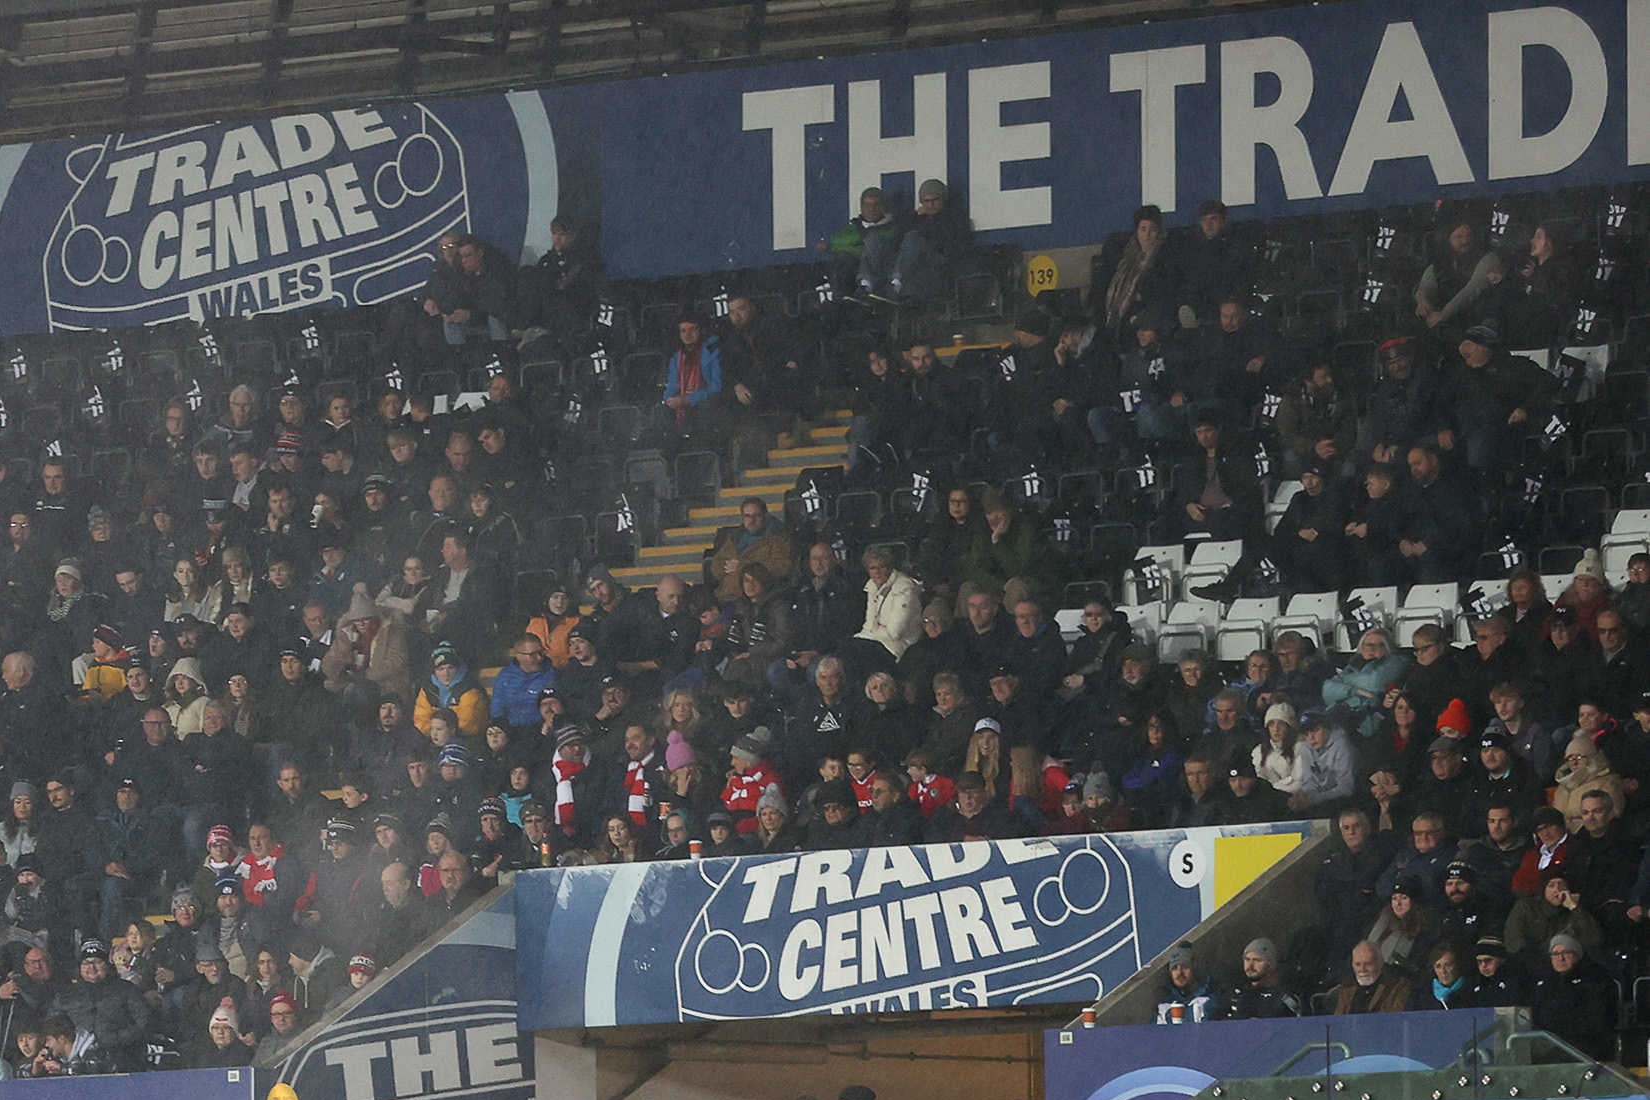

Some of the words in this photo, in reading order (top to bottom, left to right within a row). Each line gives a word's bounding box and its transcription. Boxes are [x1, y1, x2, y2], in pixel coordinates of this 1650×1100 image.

[105, 107, 398, 218] TRADE
[742, 59, 1052, 251] THE
[1110, 2, 1650, 213] TRAD
[138, 162, 380, 290] CENTRE
[1030, 268, 1054, 285] 139
[198, 262, 325, 319] WALES
[1181, 852, 1193, 873] S
[777, 876, 1039, 1001] CENTRE
